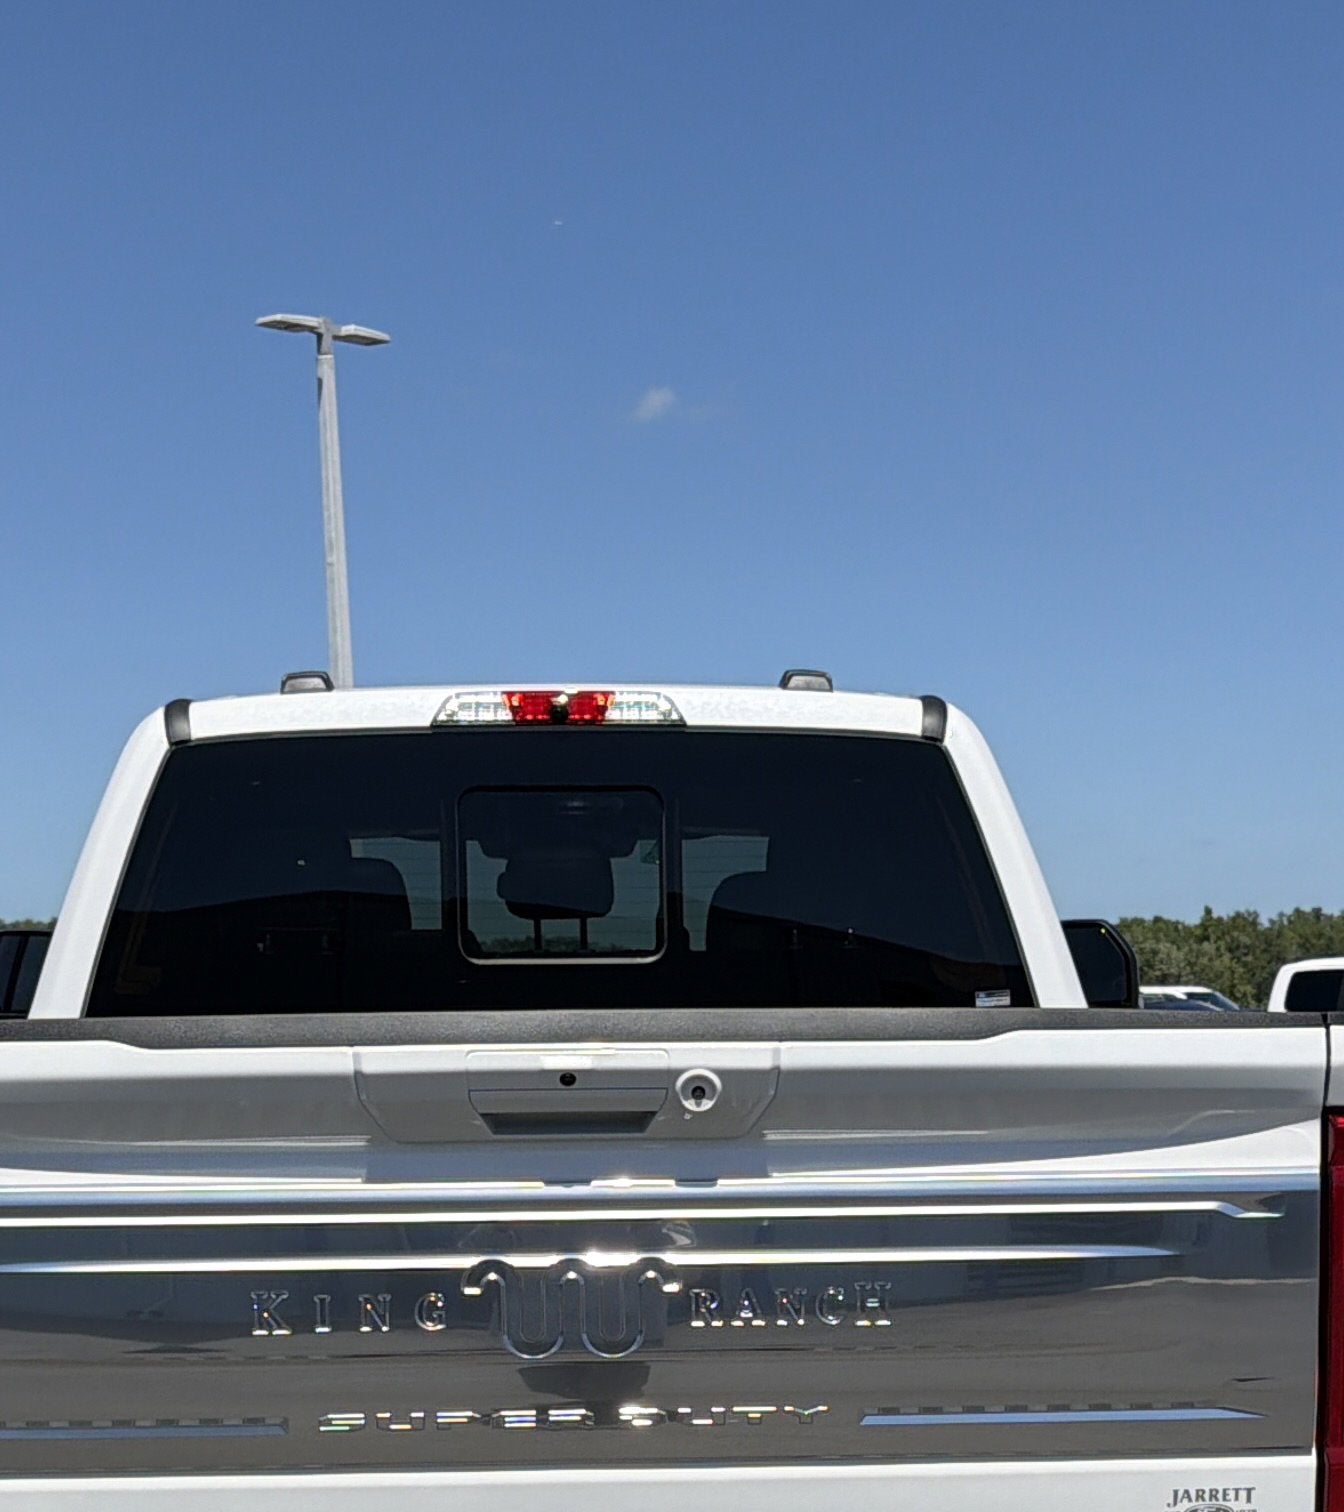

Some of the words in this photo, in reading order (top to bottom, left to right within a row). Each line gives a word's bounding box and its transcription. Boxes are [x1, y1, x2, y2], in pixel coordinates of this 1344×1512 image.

[250, 1290, 448, 1336] KING
[689, 1281, 892, 1328] RANCH
[1166, 1486, 1257, 1508] JARRETT
